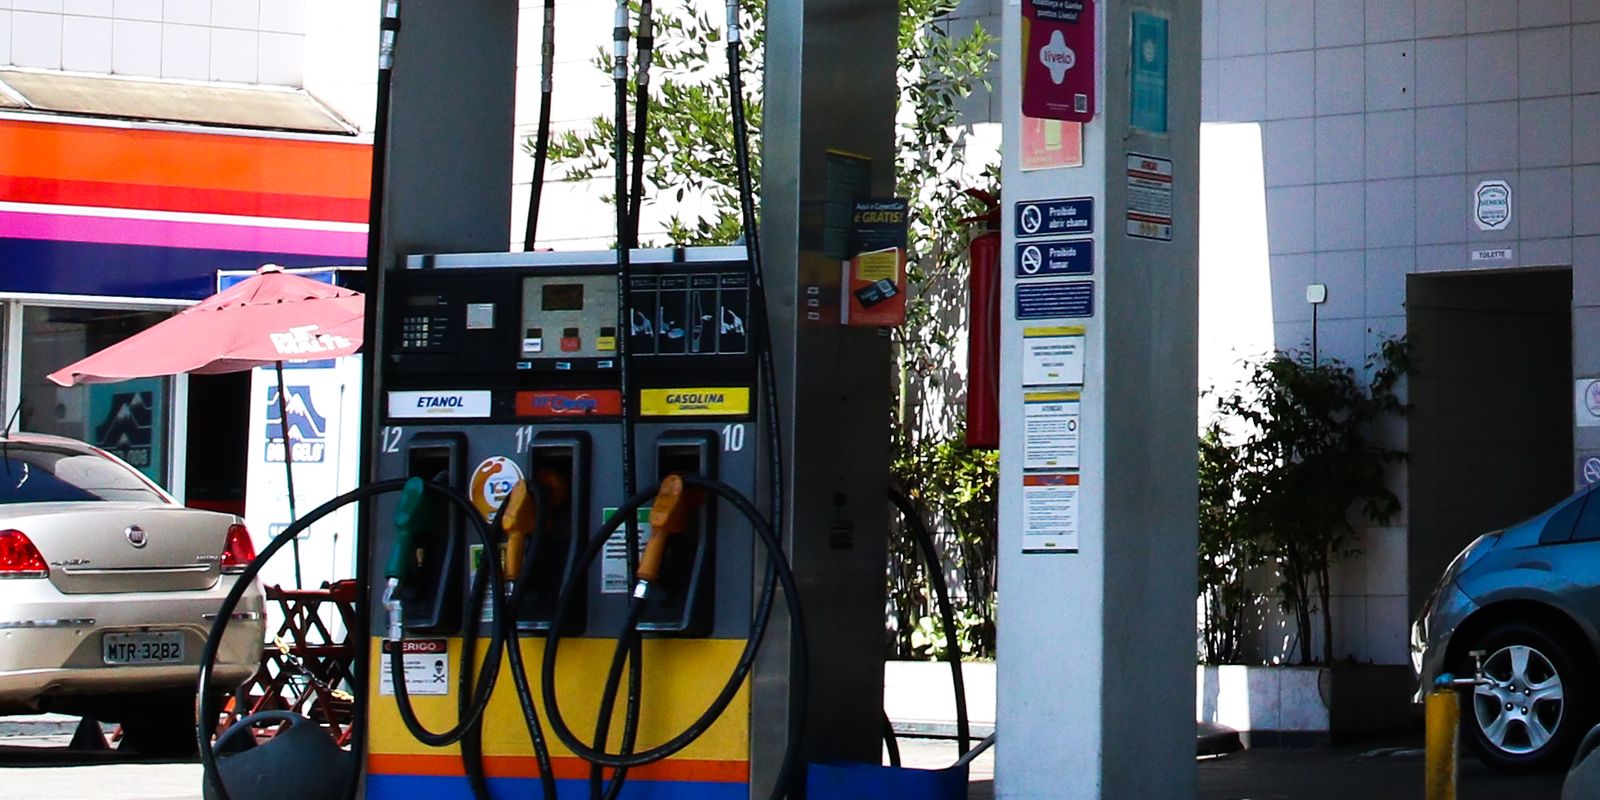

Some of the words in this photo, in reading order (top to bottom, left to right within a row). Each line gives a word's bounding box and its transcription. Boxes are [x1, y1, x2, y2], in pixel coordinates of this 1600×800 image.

[1044, 50, 1072, 64] livelo
[1049, 206, 1077, 217] Proibido
[1066, 219, 1088, 228] chama
[1049, 247, 1077, 258] Proibido
[1049, 260, 1069, 270] fumar
[416, 396, 465, 408] ETANOL
[665, 393, 725, 405] GASOLINA
[381, 425, 403, 453] 12
[515, 425, 534, 453] 11
[722, 423, 745, 452] 10
[108, 642, 180, 660] MTR-3282
[402, 642, 437, 651] ERIGO
